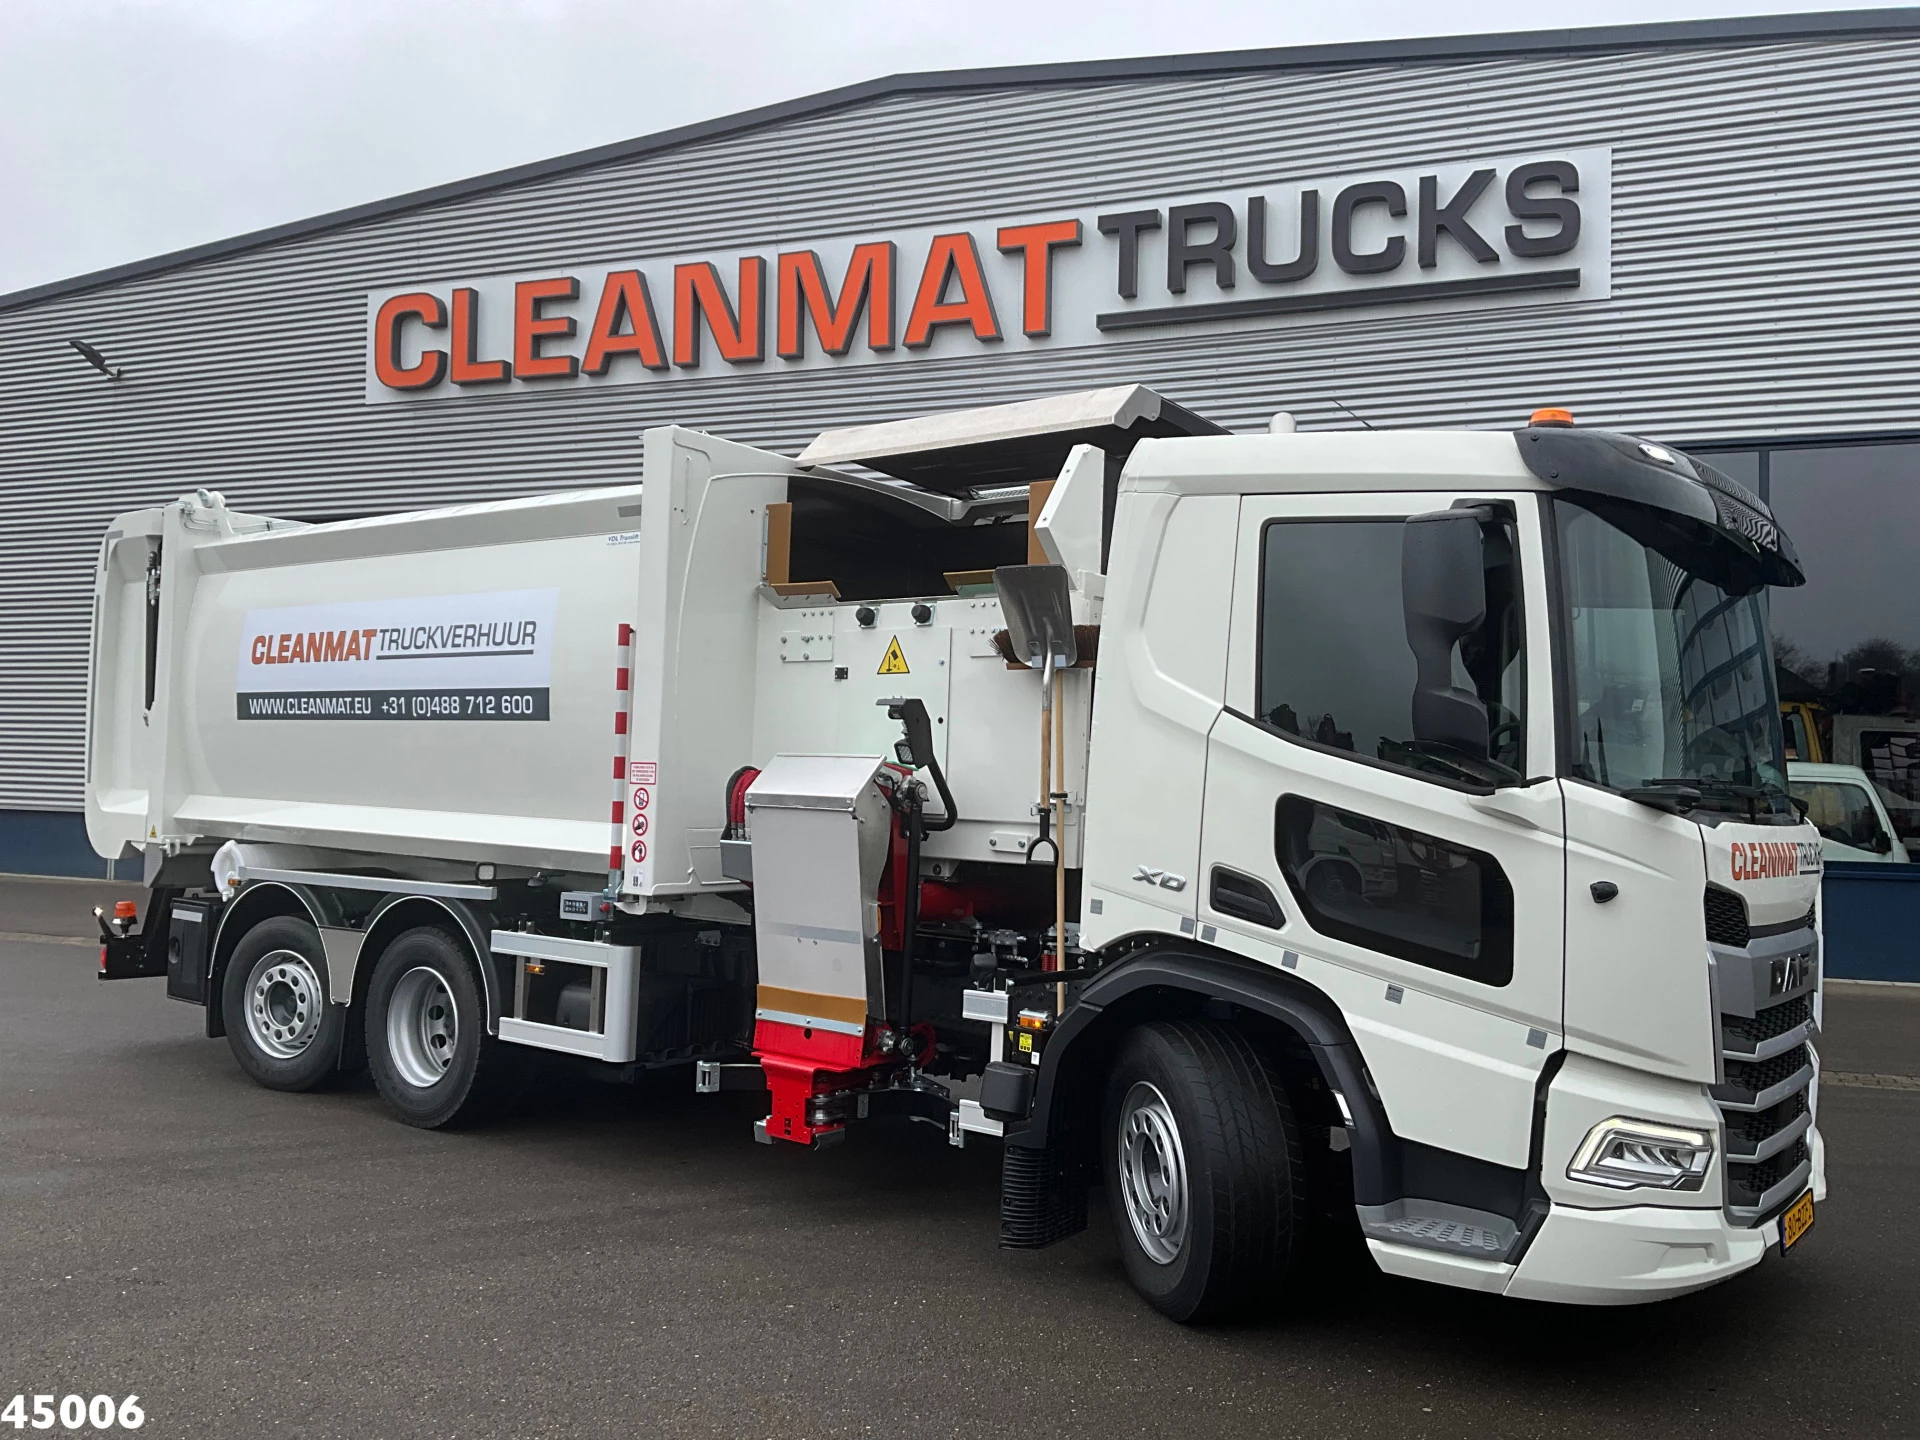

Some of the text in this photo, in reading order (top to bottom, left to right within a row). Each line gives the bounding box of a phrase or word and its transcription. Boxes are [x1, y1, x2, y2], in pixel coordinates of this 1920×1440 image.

[374, 160, 1582, 391] CLEANMAT TRUCKS
[251, 620, 537, 665] CLEANMAT TRUCKVERHUUR
[249, 695, 533, 717] WWW.CLEANMAT.EU +31 (0)488 712 600
[1132, 864, 1187, 893] XD
[1730, 842, 1799, 881] CLEANMAT
[1769, 953, 1810, 997] DAF
